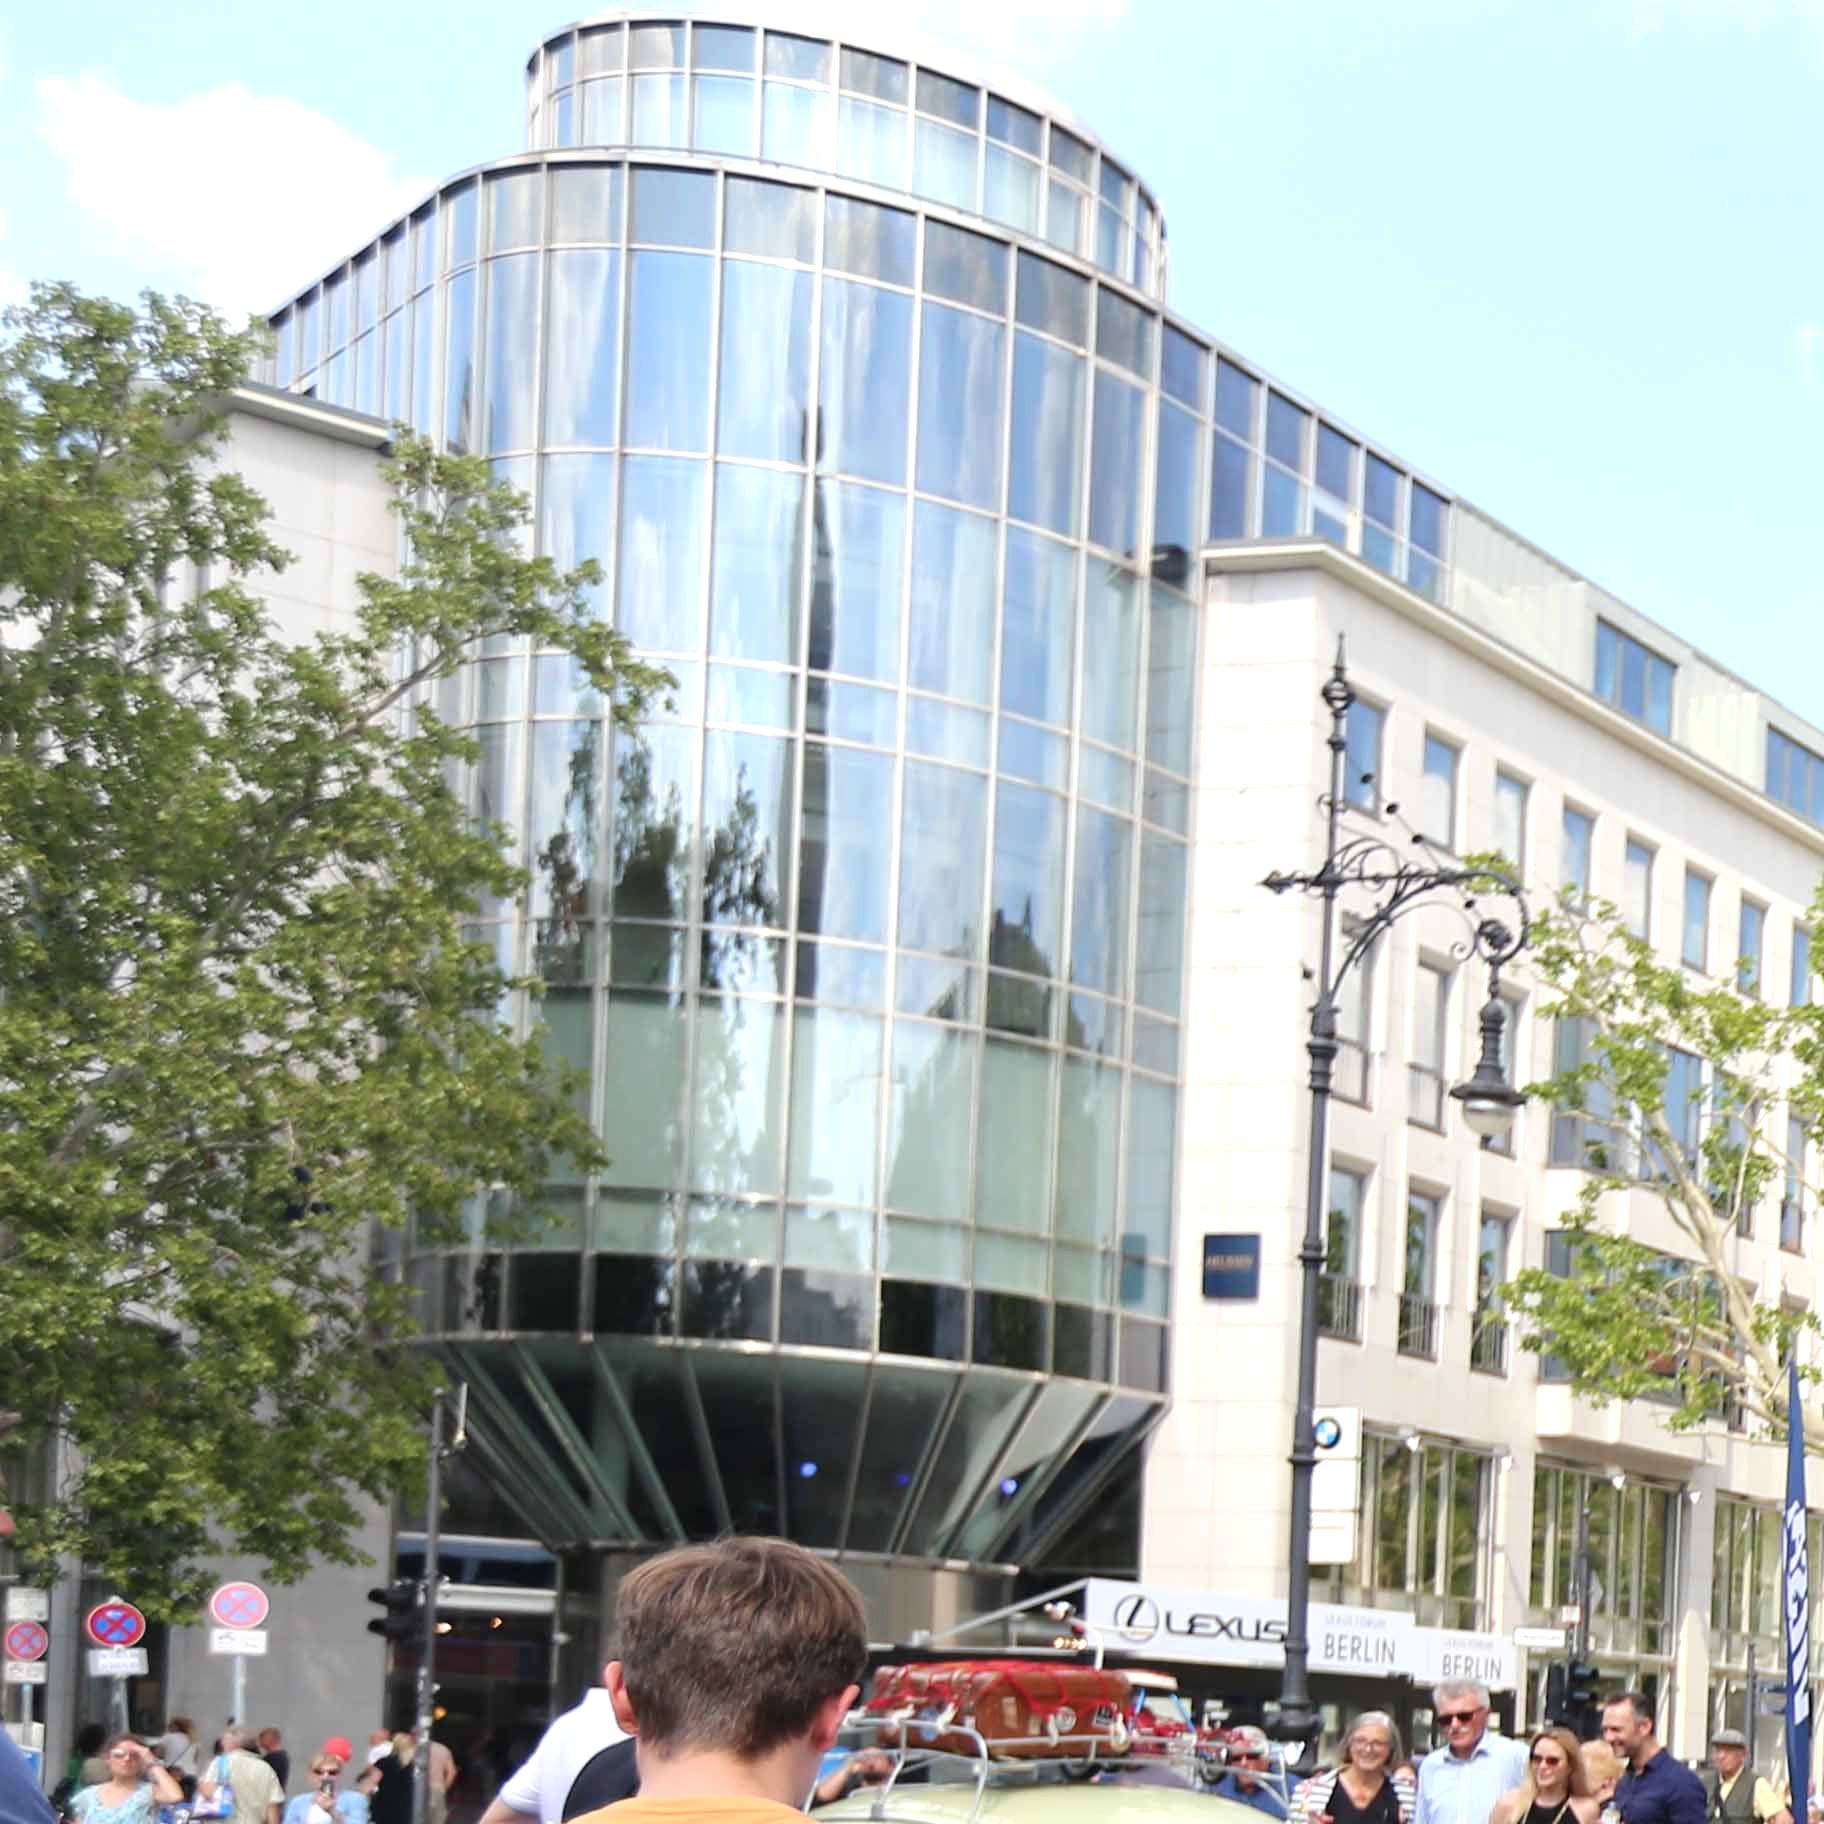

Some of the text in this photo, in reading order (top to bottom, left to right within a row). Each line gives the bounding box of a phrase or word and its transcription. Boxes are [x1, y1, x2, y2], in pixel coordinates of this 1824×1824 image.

[1165, 1612, 1288, 1642] LEXUS
[1324, 1633, 1396, 1665] BERLIN
[1442, 1653, 1502, 1680] BERLIN
